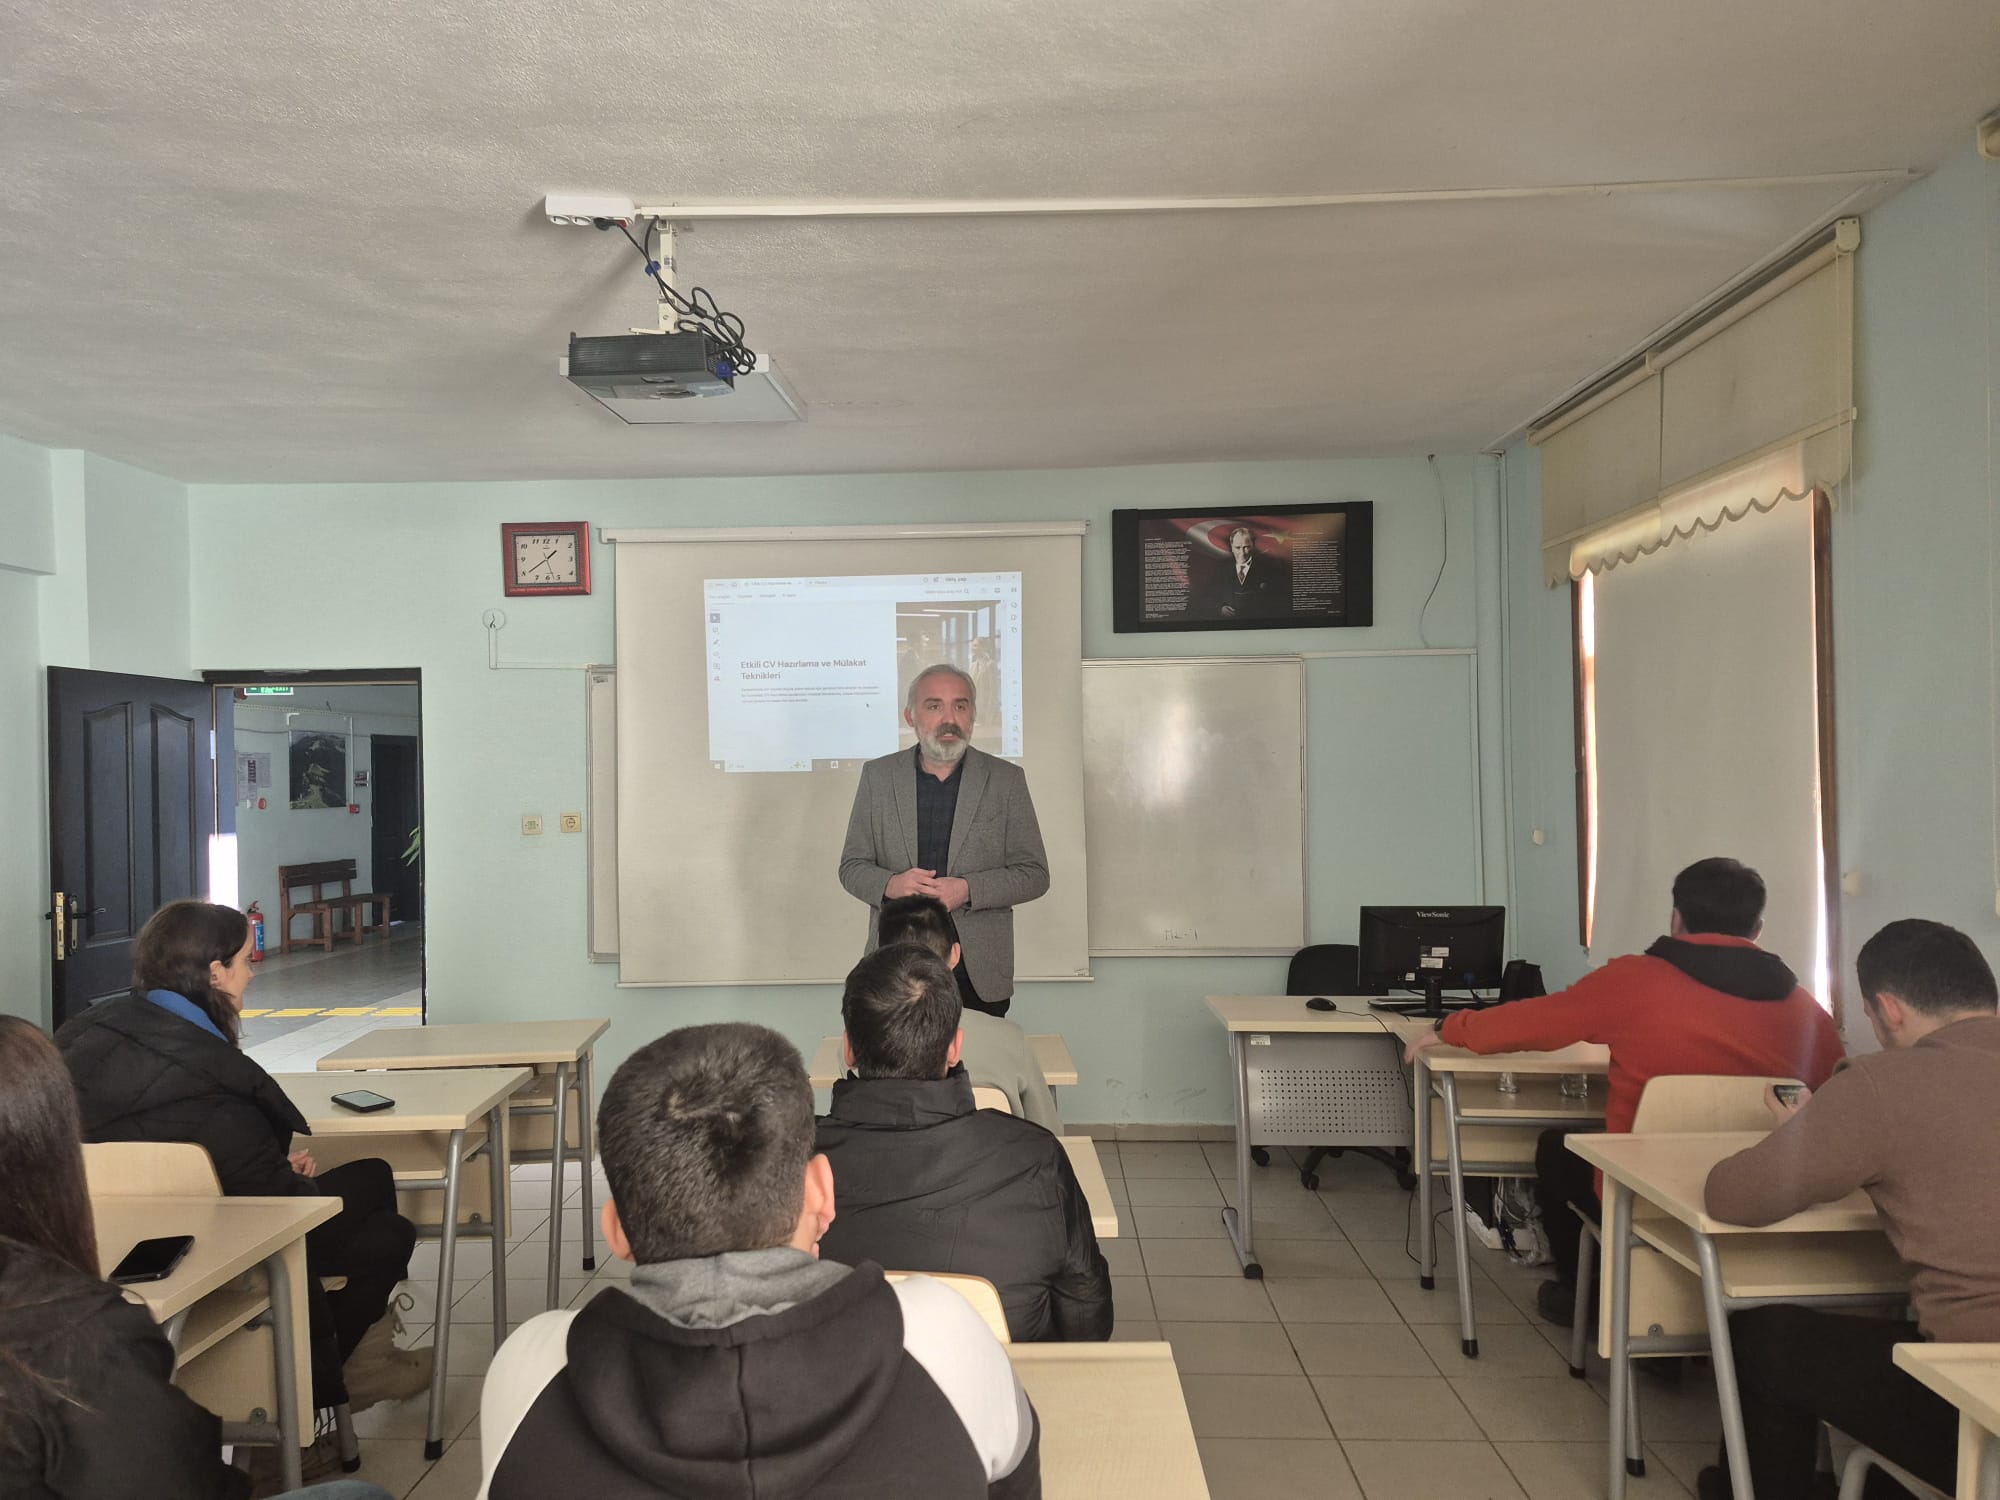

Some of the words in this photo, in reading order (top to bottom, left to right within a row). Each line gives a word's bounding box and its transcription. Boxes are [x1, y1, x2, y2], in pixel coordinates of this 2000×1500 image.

[740, 660, 761, 669] Etkili
[763, 660, 776, 668] CV
[777, 660, 820, 668] Hazırlama
[833, 658, 867, 667] Mülakat
[740, 671, 781, 680] Teknikleri
